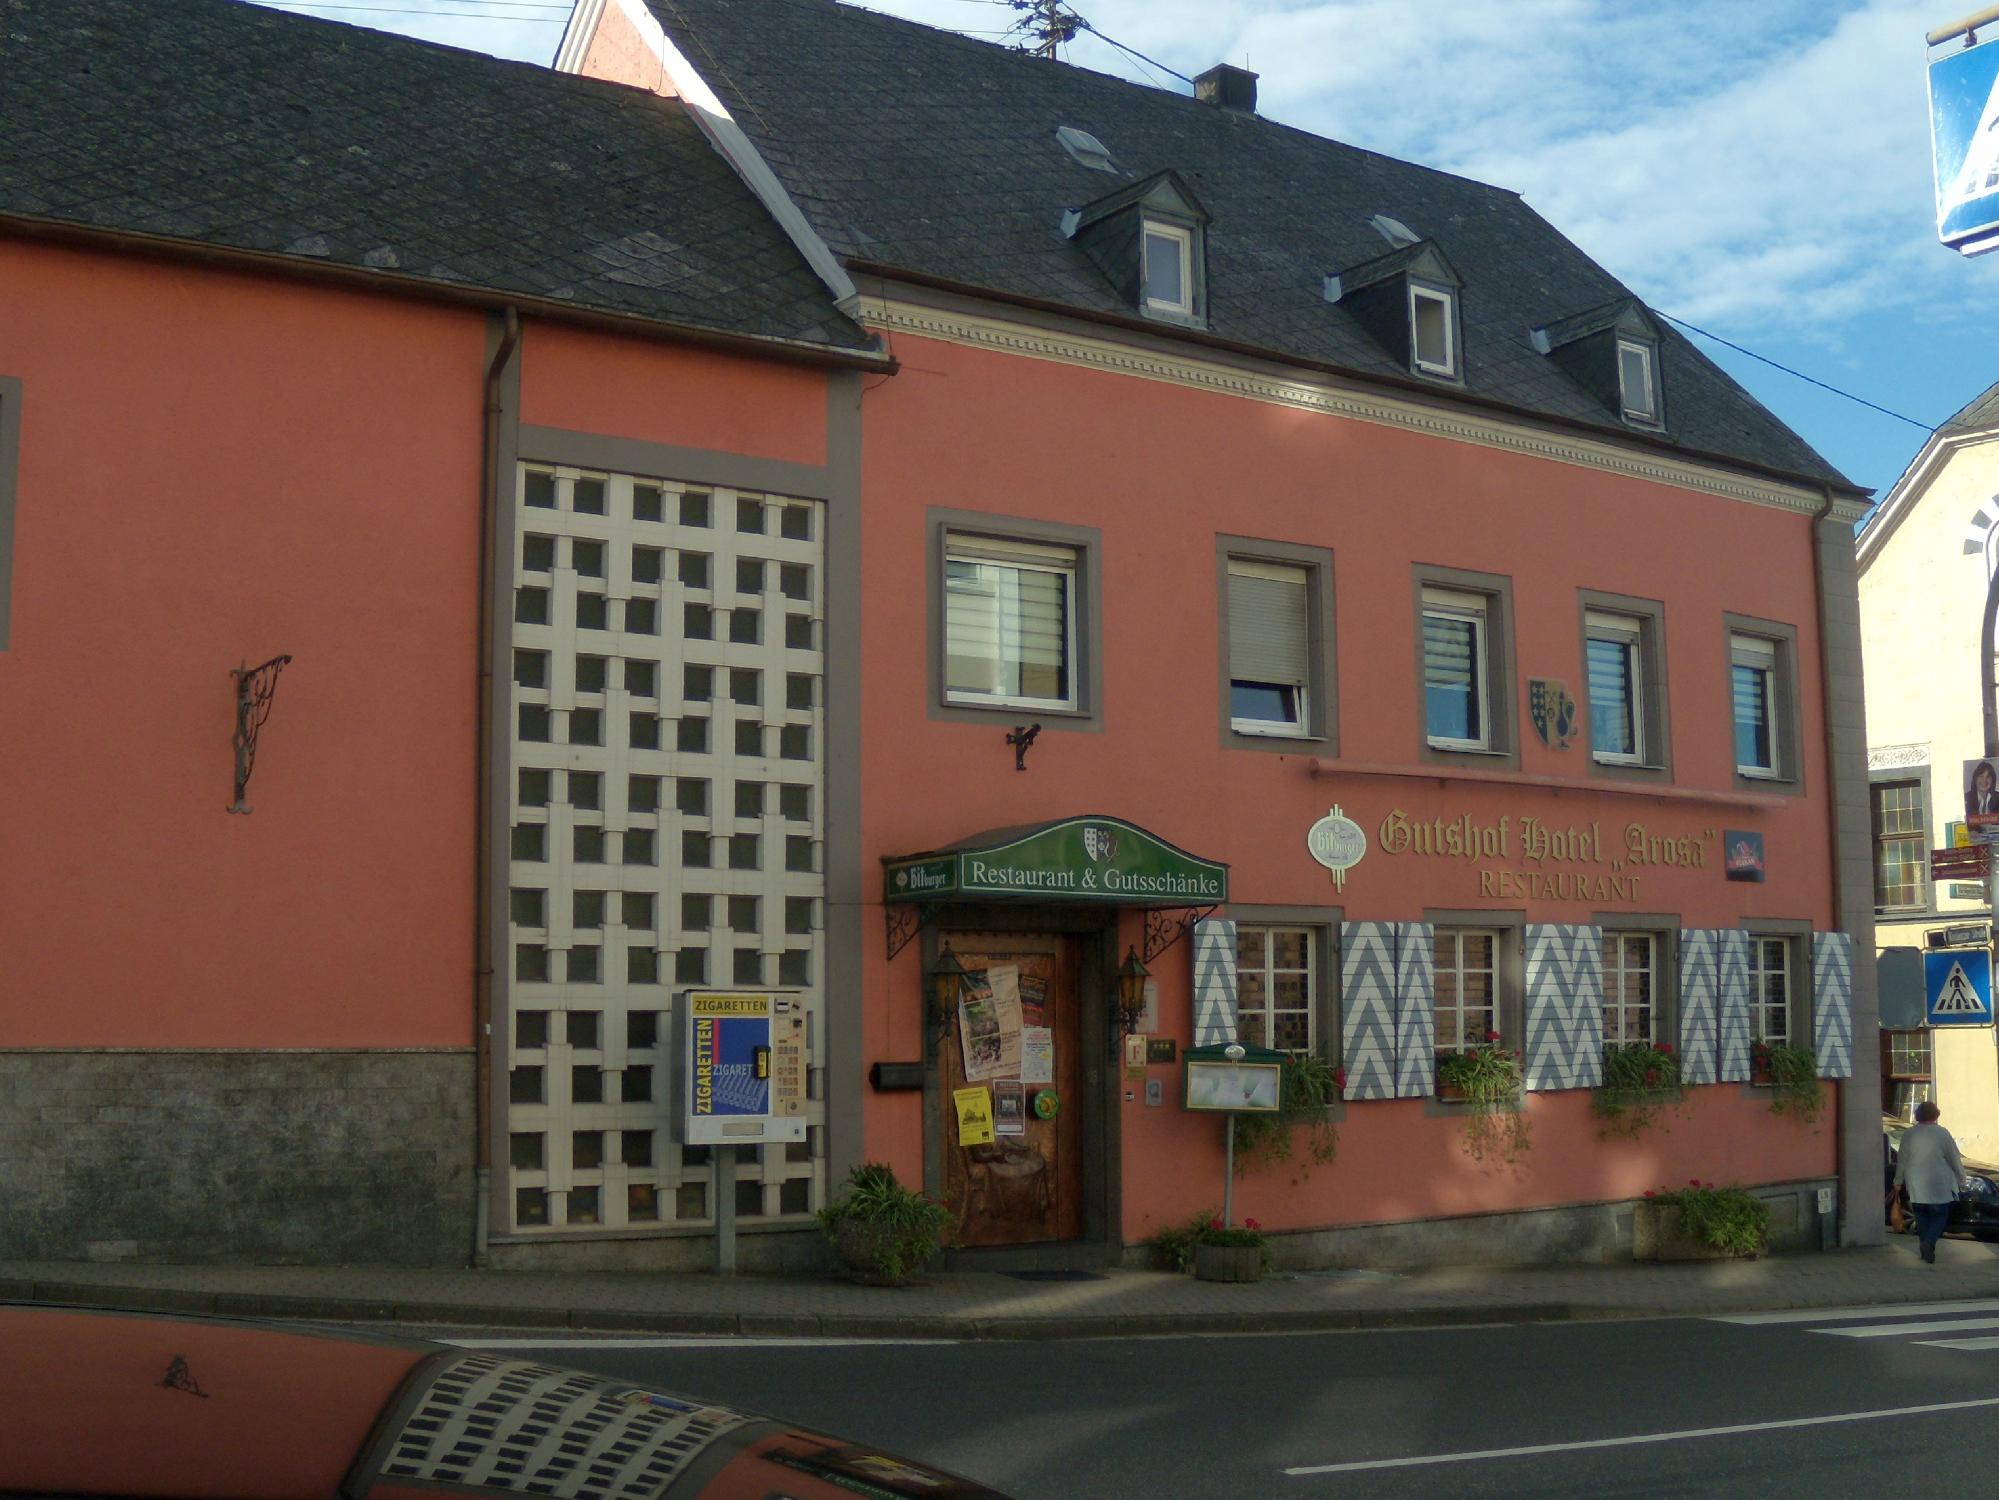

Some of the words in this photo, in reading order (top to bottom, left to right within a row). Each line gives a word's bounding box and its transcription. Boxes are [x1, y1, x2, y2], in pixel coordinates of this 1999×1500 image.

[1380, 809, 1510, 864] Gutshof
[1520, 815, 1603, 868] Hotel
[972, 861, 1076, 888] Restaurant
[1081, 867, 1098, 889] &
[1103, 868, 1218, 894] Gutsschänke
[1480, 870, 1640, 902] RESTAURANT
[695, 1000, 767, 1011] ZIGARETTEN
[697, 1020, 712, 1113] ZIGARETTEN
[713, 1064, 753, 1076] ZIGARET
